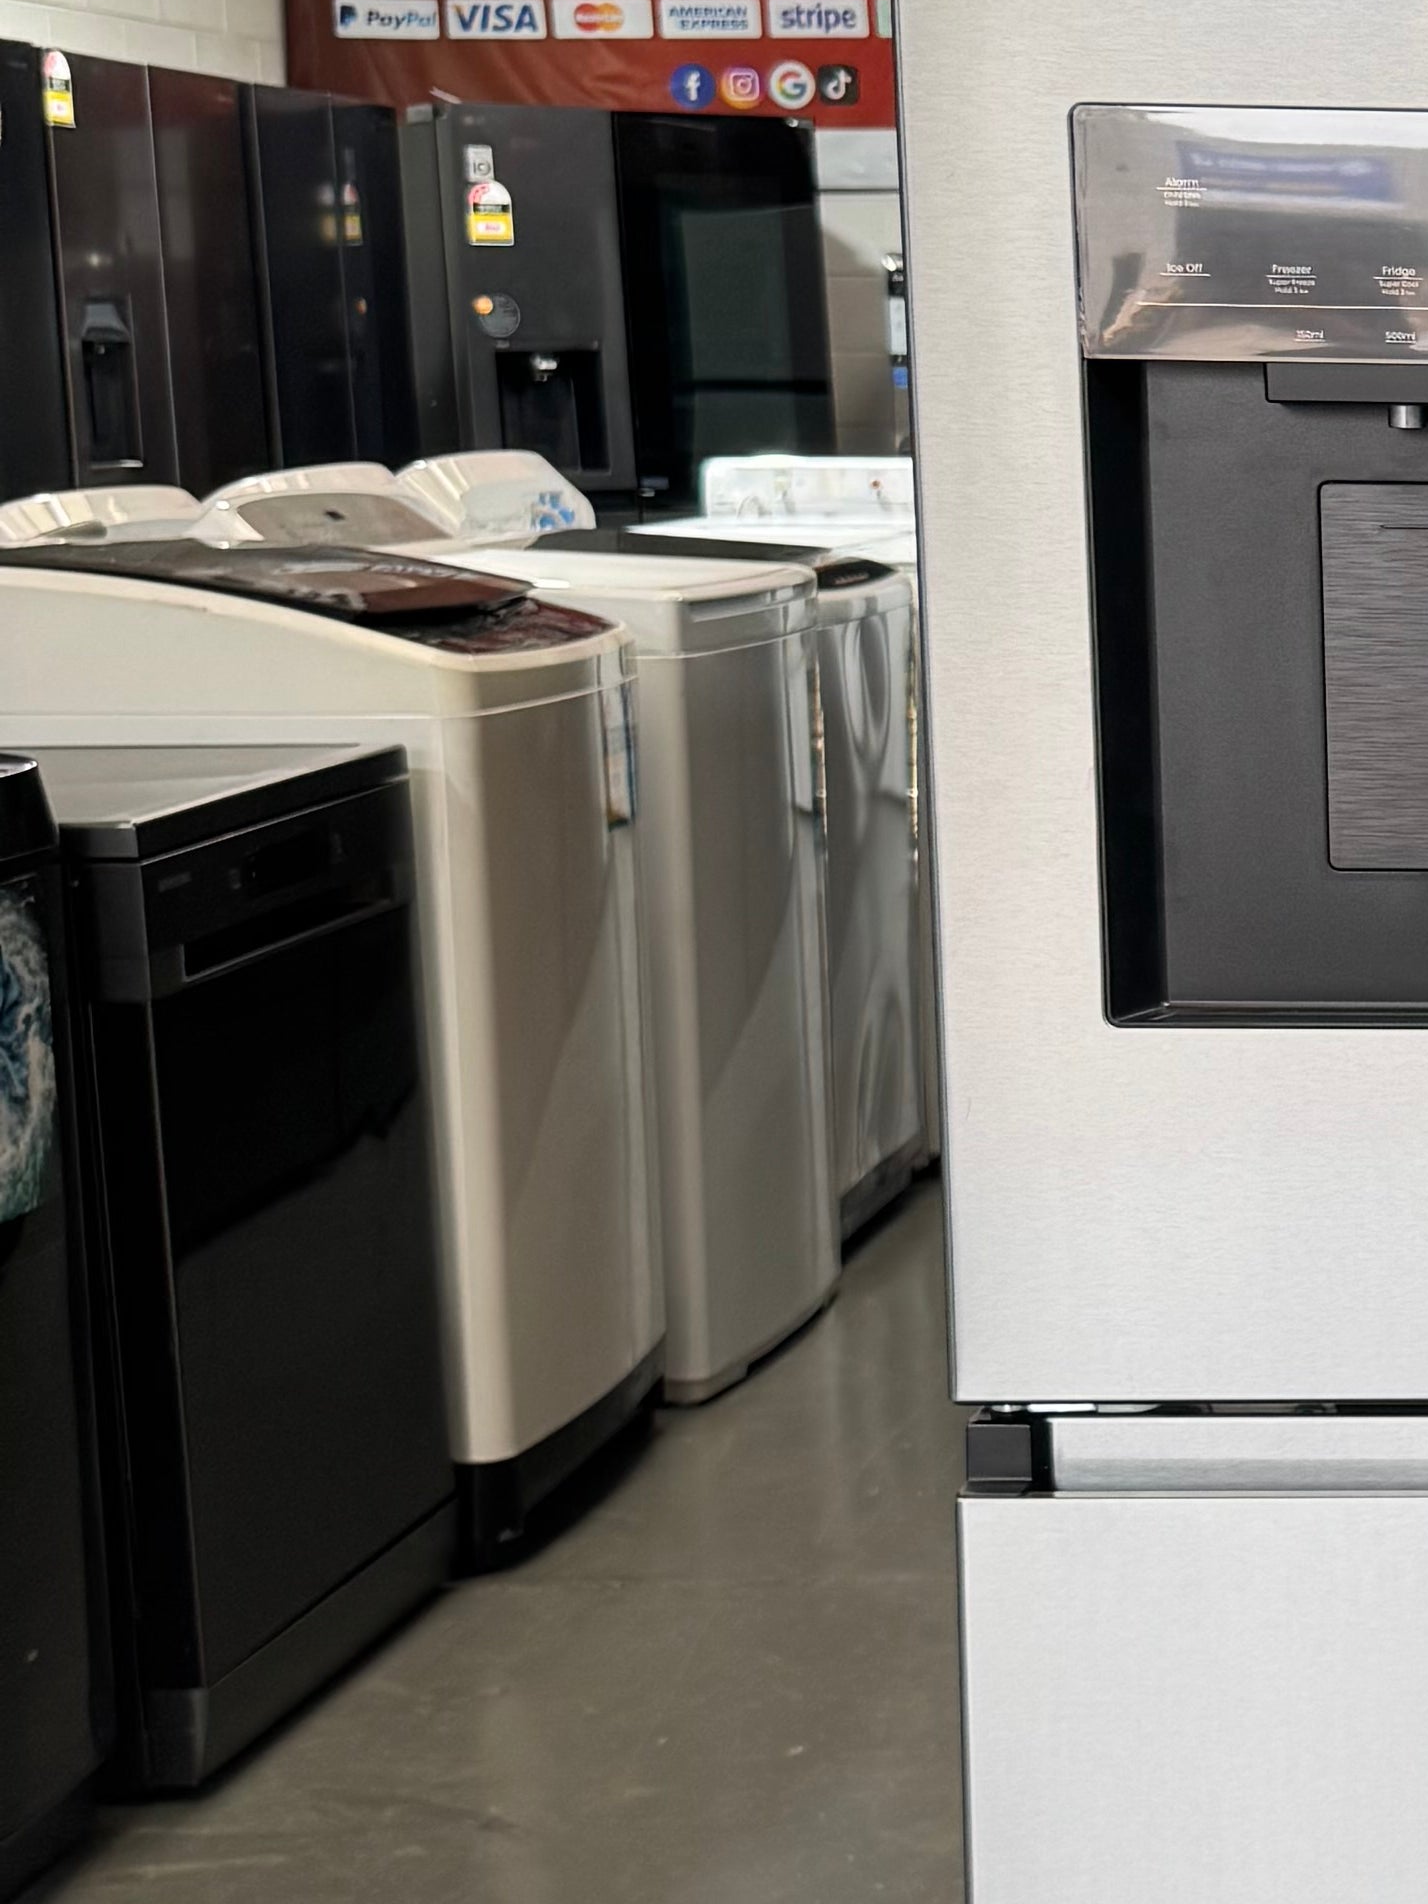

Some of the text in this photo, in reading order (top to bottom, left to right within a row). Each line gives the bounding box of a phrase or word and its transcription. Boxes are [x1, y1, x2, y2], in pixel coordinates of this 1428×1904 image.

[366, 8, 437, 30] PayPal
[454, 4, 540, 34] VISA
[668, 5, 749, 19] AMERICAN
[679, 18, 750, 32] EXPRESS
[780, 4, 858, 35] stripe
[1164, 177, 1200, 188] Alarm
[1166, 263, 1203, 273] Ice Off
[1271, 264, 1312, 275] Freezer
[1382, 265, 1416, 277] Fridge
